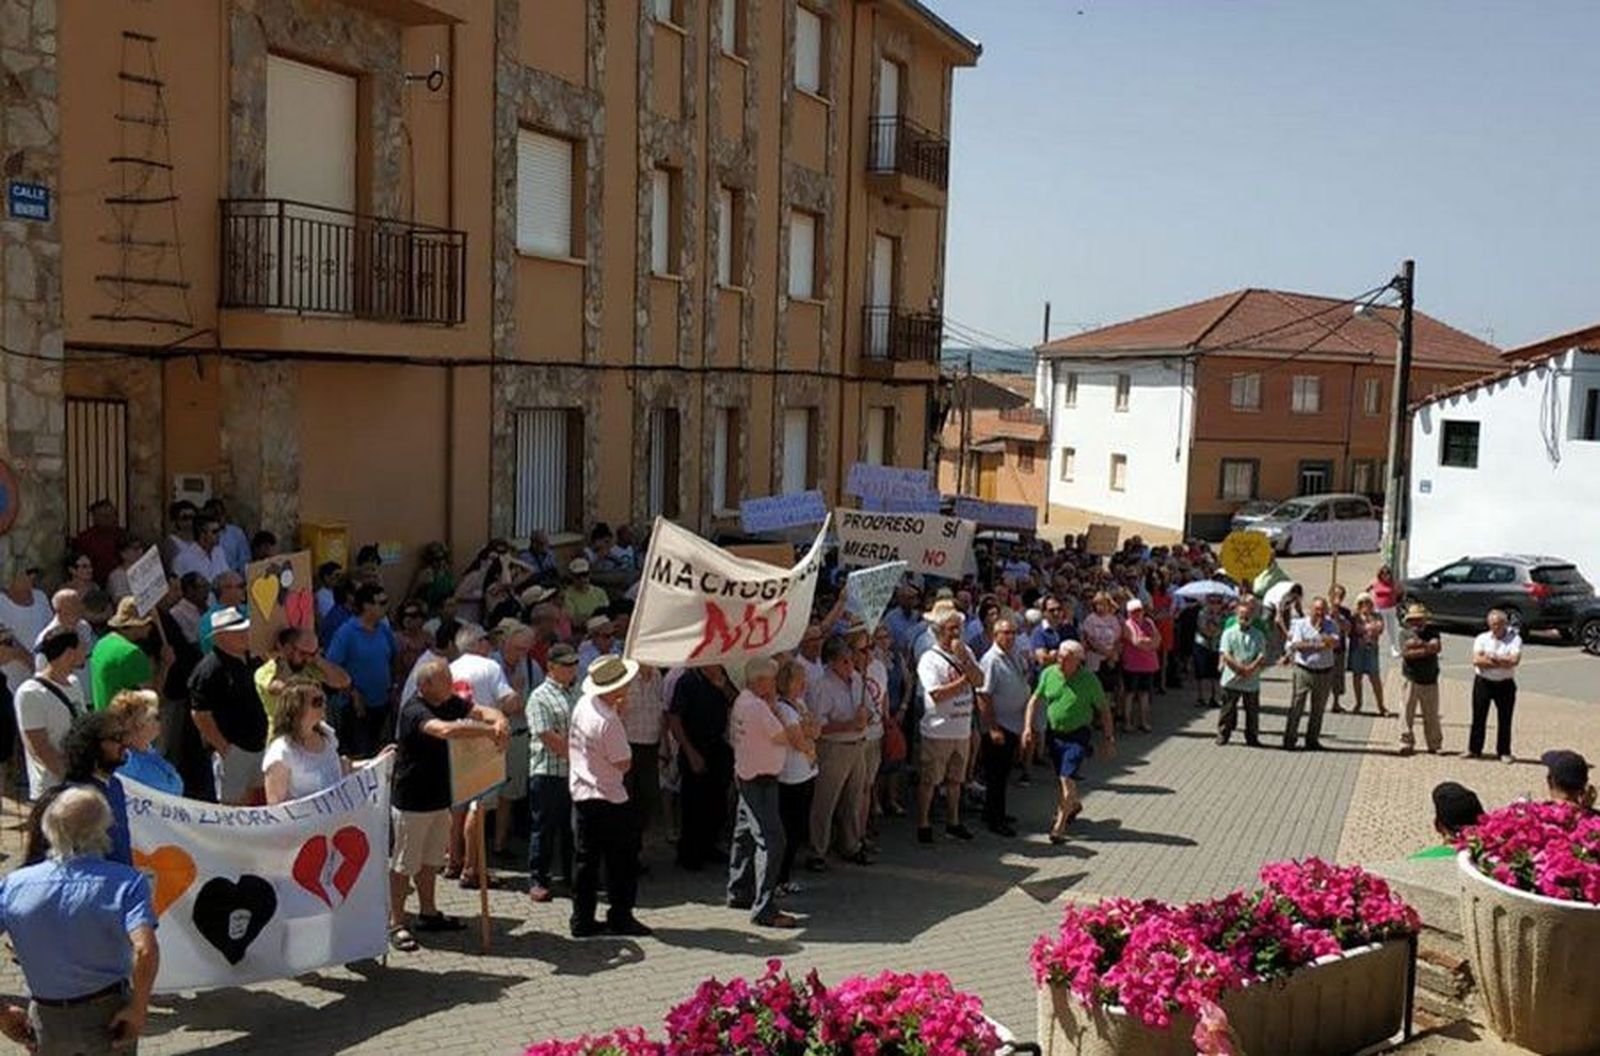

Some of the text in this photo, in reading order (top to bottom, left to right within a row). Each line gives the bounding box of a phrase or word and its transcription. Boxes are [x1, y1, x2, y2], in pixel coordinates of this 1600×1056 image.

[12, 185, 46, 200] CALLE
[842, 513, 925, 535] PROGRESO
[843, 540, 947, 568] MIERDA NO
[687, 600, 788, 662] NO
